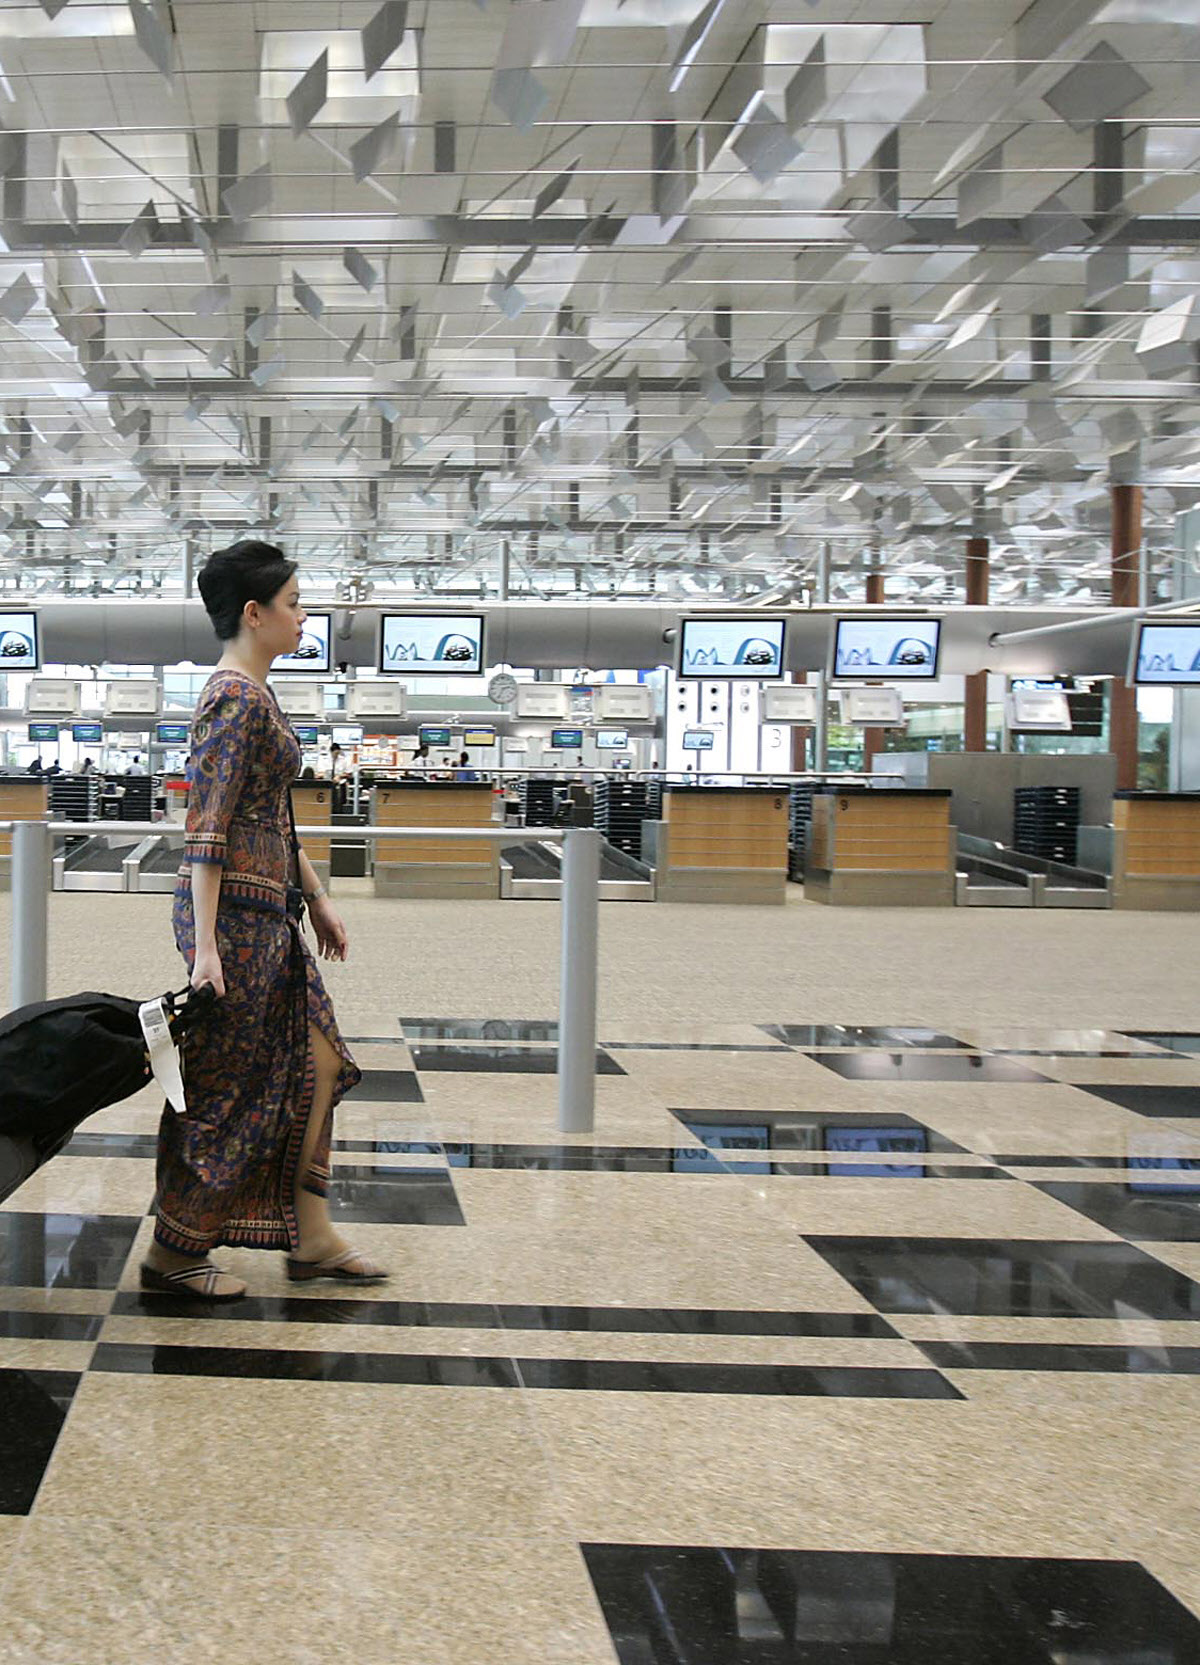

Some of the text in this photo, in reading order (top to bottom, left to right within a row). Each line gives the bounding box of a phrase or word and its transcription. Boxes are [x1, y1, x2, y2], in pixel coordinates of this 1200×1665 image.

[316, 792, 325, 803] 6
[382, 793, 390, 804] 7
[840, 799, 849, 811] 9
